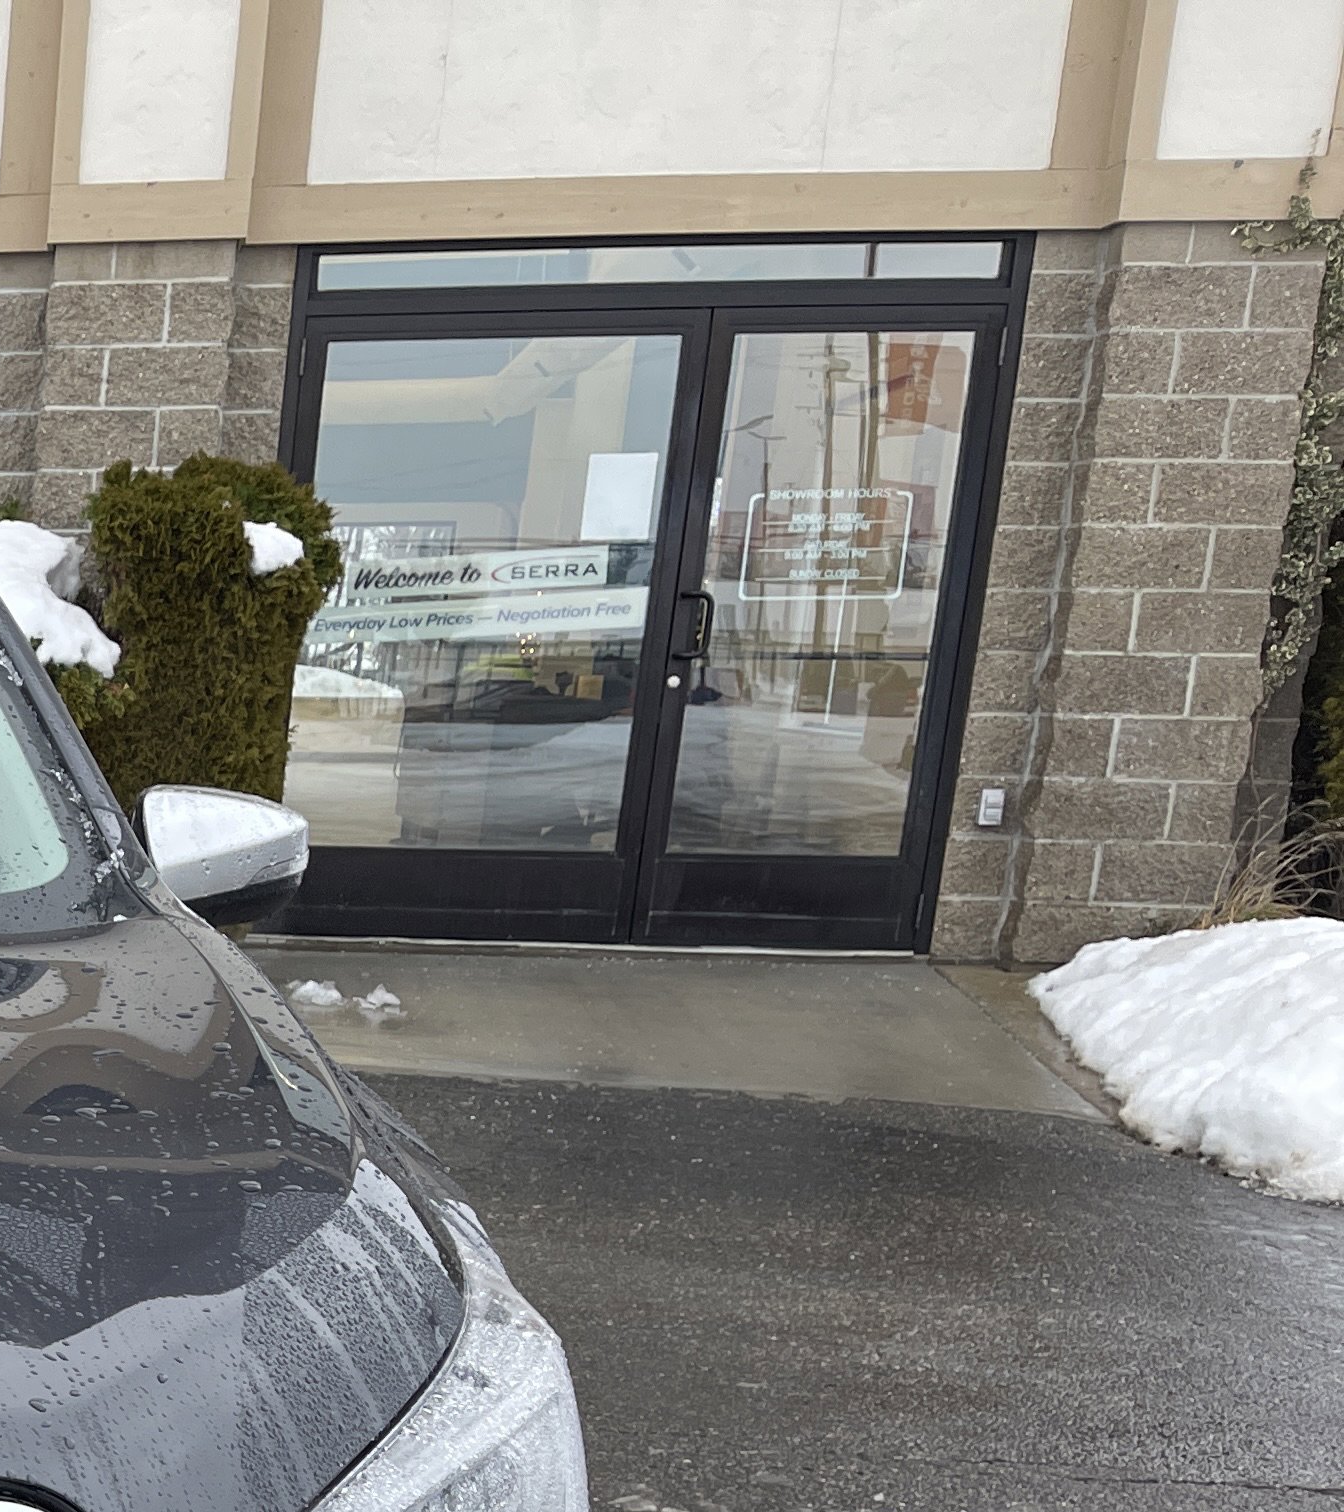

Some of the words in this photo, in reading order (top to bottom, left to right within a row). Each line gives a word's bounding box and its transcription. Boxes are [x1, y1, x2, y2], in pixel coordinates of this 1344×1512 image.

[769, 489, 845, 500] SHOWROOM
[848, 487, 892, 498] HOURS
[353, 566, 455, 590] Welcome
[460, 562, 482, 584] to
[510, 562, 599, 580] SERRA
[314, 618, 385, 634] Everyday
[388, 616, 423, 629] Low
[425, 613, 473, 627] Prices
[496, 605, 591, 624] Negotiation
[595, 602, 632, 617] Free
